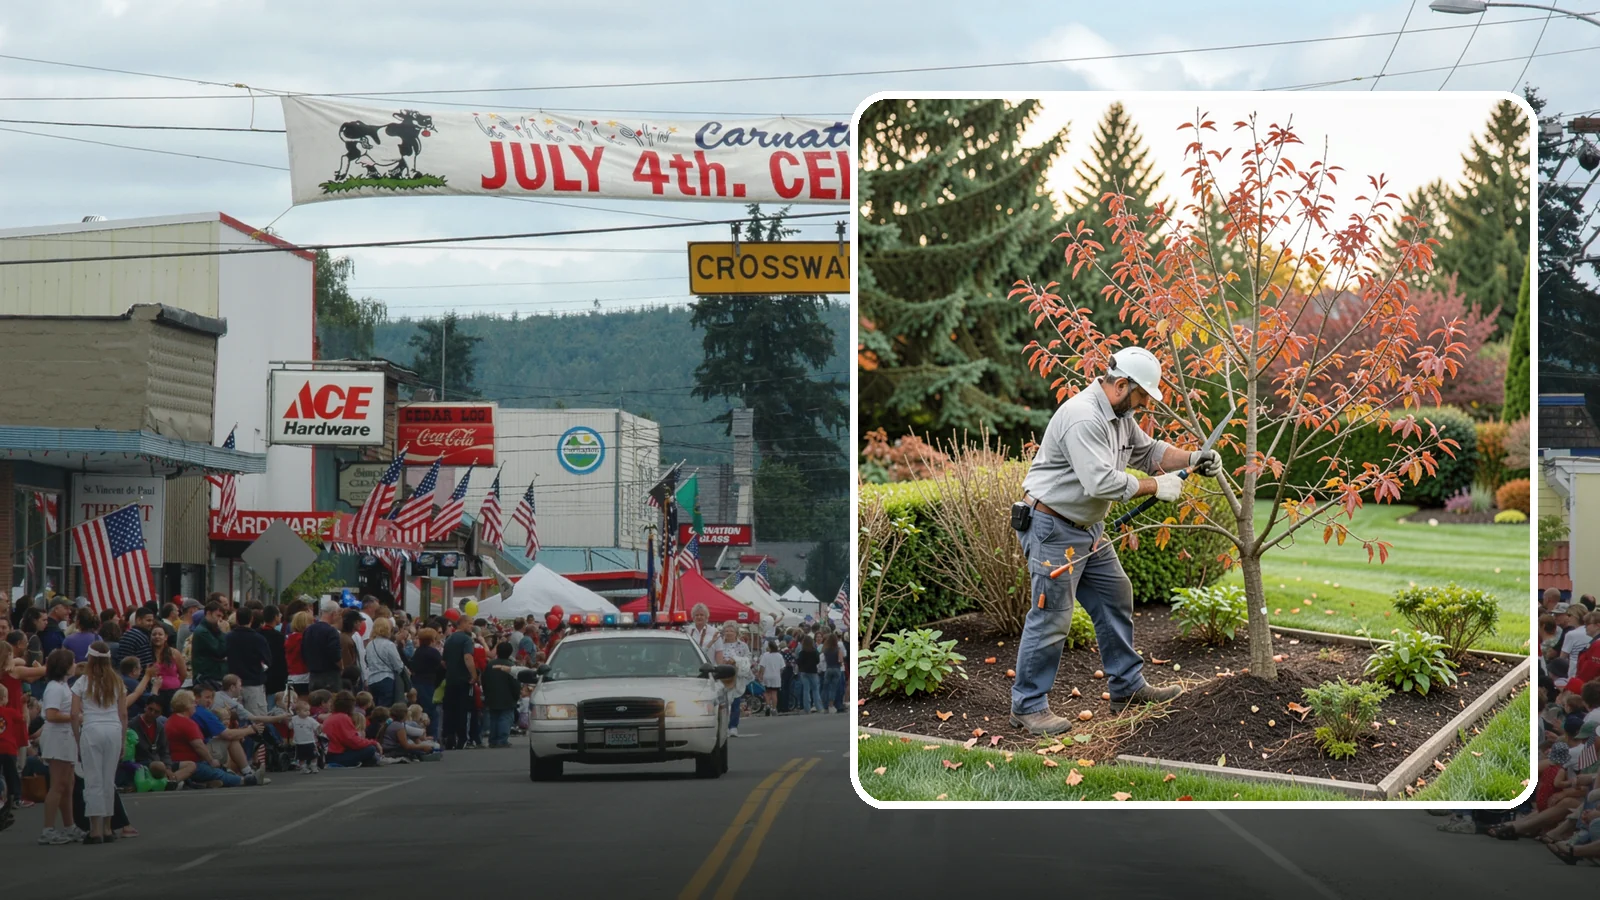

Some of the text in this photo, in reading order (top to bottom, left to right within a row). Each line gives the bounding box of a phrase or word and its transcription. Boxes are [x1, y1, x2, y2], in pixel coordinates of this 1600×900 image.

[695, 121, 850, 150] Carnat
[481, 141, 605, 192] JULY
[632, 150, 746, 198] 4th.
[697, 254, 850, 280] CROSSWA
[283, 380, 373, 420] ACE
[406, 410, 453, 422] CEDAR
[283, 421, 371, 437] Hardware
[416, 428, 477, 447] Coca-Cola
[83, 484, 155, 495] St. Vincent de Paul
[688, 526, 741, 535] CRNATION
[699, 535, 730, 543] GLASS
